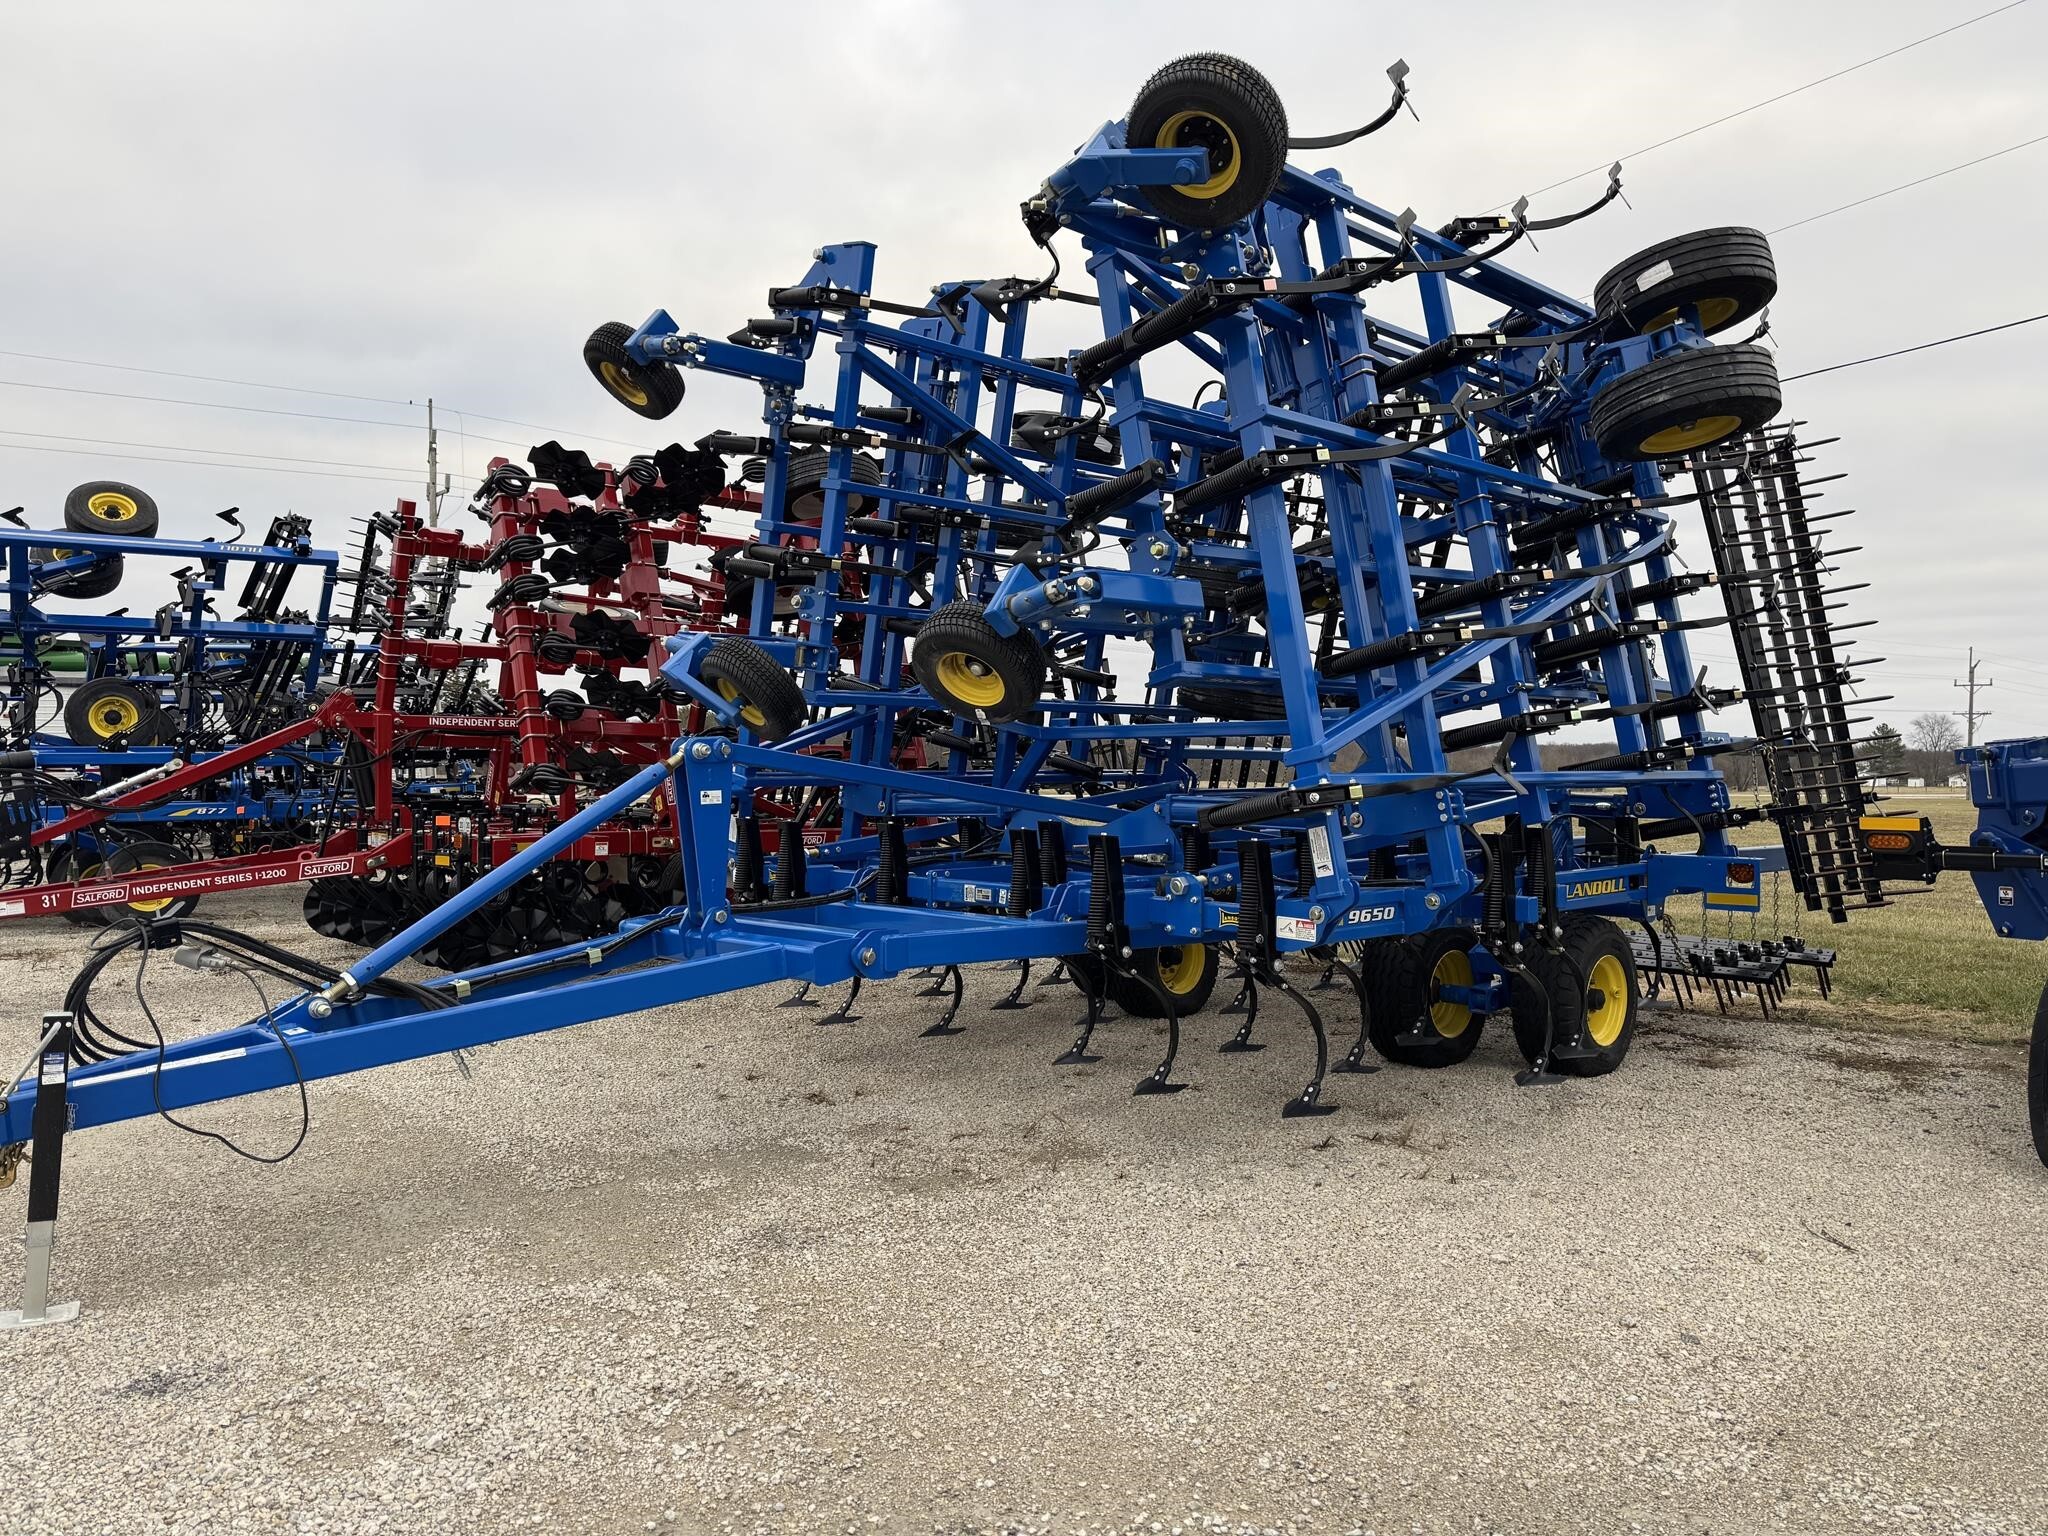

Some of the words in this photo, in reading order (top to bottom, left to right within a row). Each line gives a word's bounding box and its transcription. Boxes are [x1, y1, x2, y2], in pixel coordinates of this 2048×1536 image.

[429, 717, 497, 727] INDEPENDENT
[197, 807, 228, 815] 877
[41, 893, 60, 908] 31'
[76, 889, 125, 903] SALFORD
[132, 878, 212, 896] INDEPENDENT
[214, 872, 253, 886] SERIES
[255, 868, 287, 881] I-1200
[303, 860, 349, 876] SALFORD
[1566, 878, 1627, 899] LANDOLL
[1348, 907, 1395, 924] 9650
